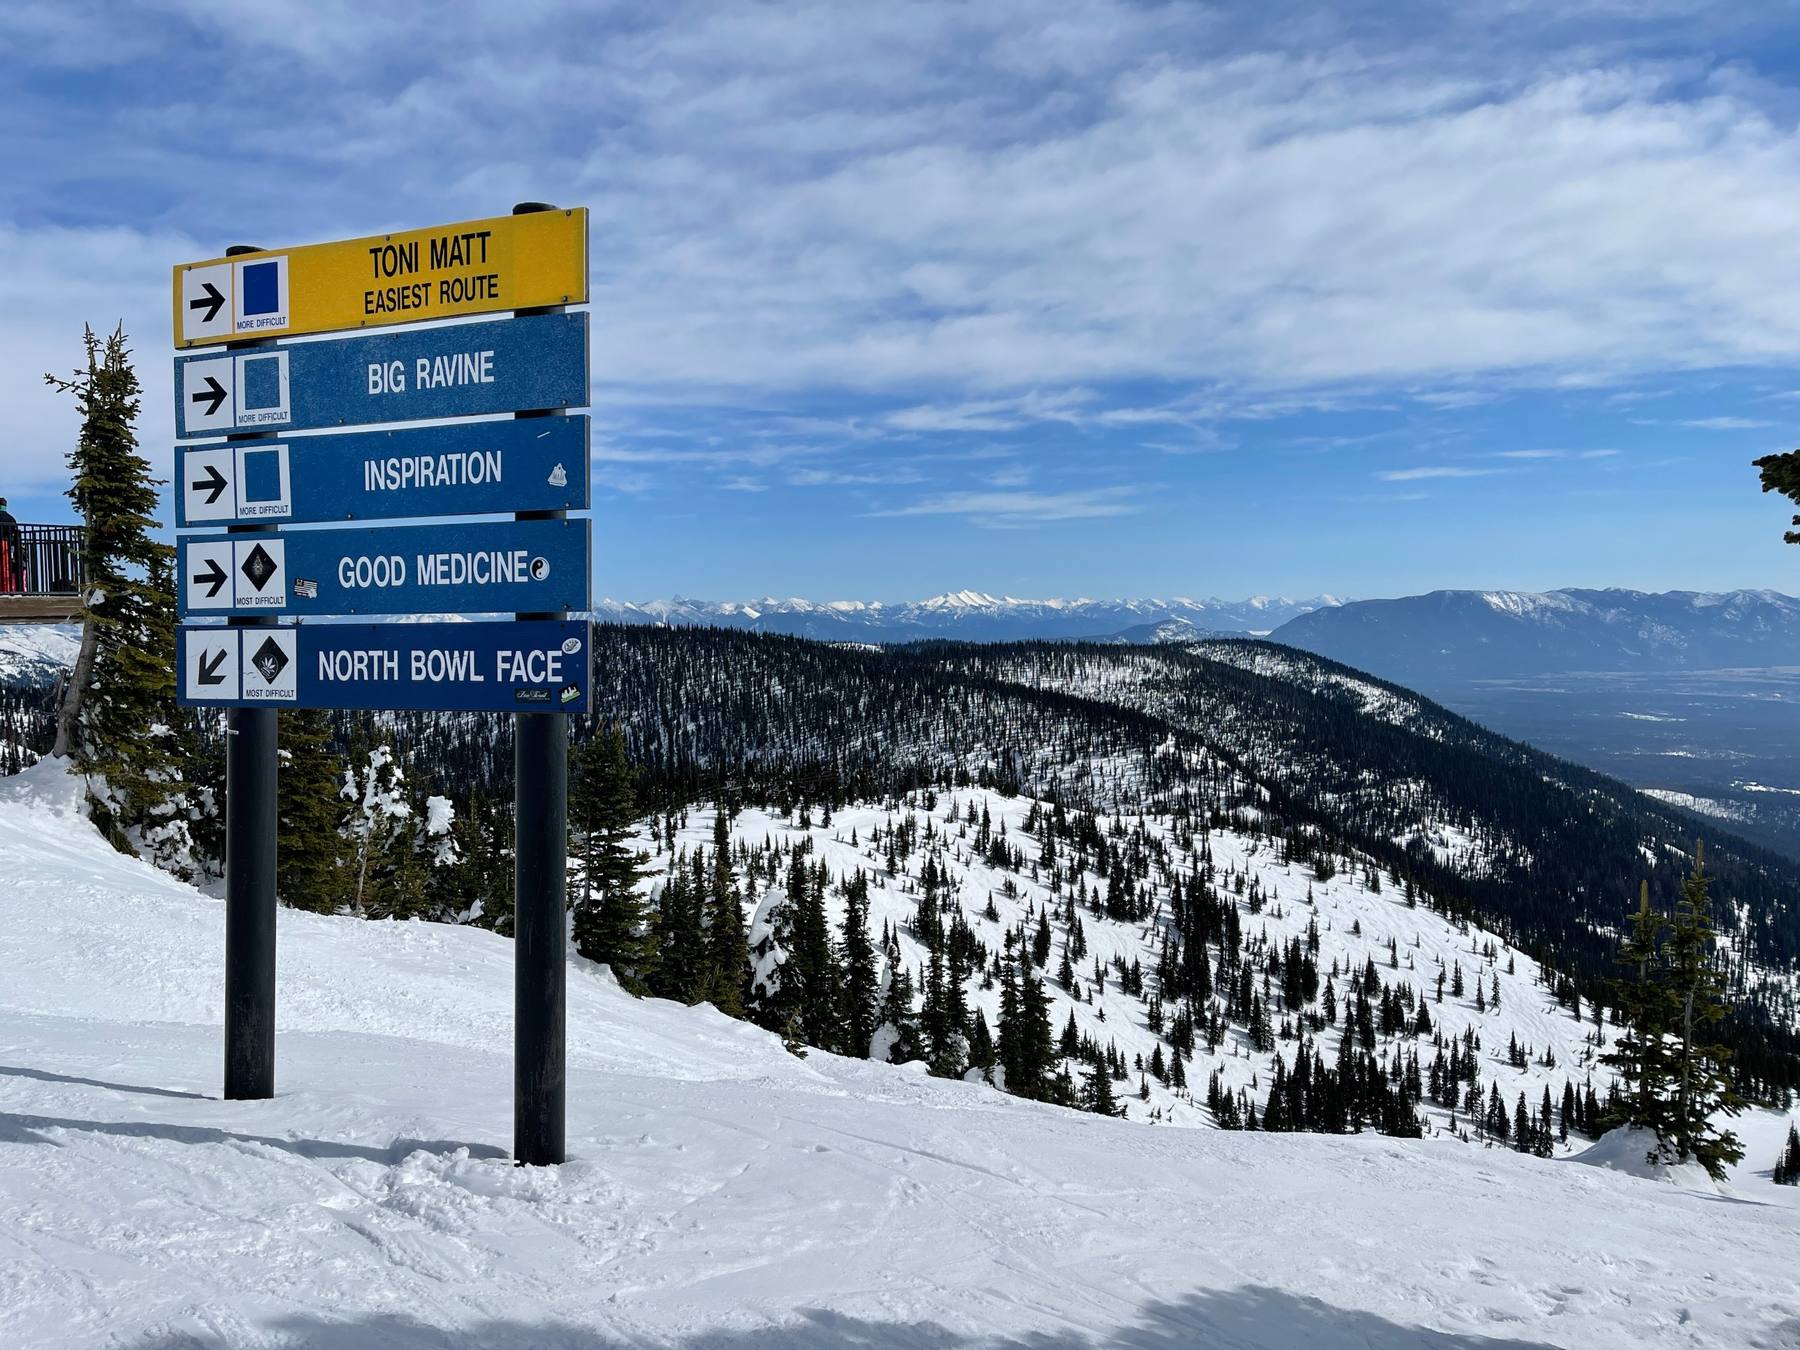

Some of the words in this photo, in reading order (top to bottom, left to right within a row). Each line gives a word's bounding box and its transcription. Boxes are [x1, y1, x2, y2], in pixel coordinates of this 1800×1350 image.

[369, 241, 419, 279] TONI
[430, 231, 491, 270] MATT
[364, 281, 432, 315] EASIEST
[439, 274, 499, 305] ROUTE
[237, 320, 254, 329] MORE
[256, 316, 286, 327] DIFFICULT
[368, 361, 405, 395] BIG
[416, 350, 495, 390] RAVINE
[239, 414, 256, 423] MORE
[258, 411, 288, 422] DIFFICULT
[364, 450, 502, 491] INSPIRATION
[240, 507, 257, 515] MORE
[259, 504, 288, 514] DIFFICULT
[338, 556, 406, 589] GOOD
[417, 550, 528, 586] MEDICINE
[237, 597, 253, 605] MOST
[255, 596, 284, 604] DIFFICULT
[318, 650, 399, 681] NORTH
[411, 650, 484, 683] BOWL
[496, 649, 563, 683] FACE
